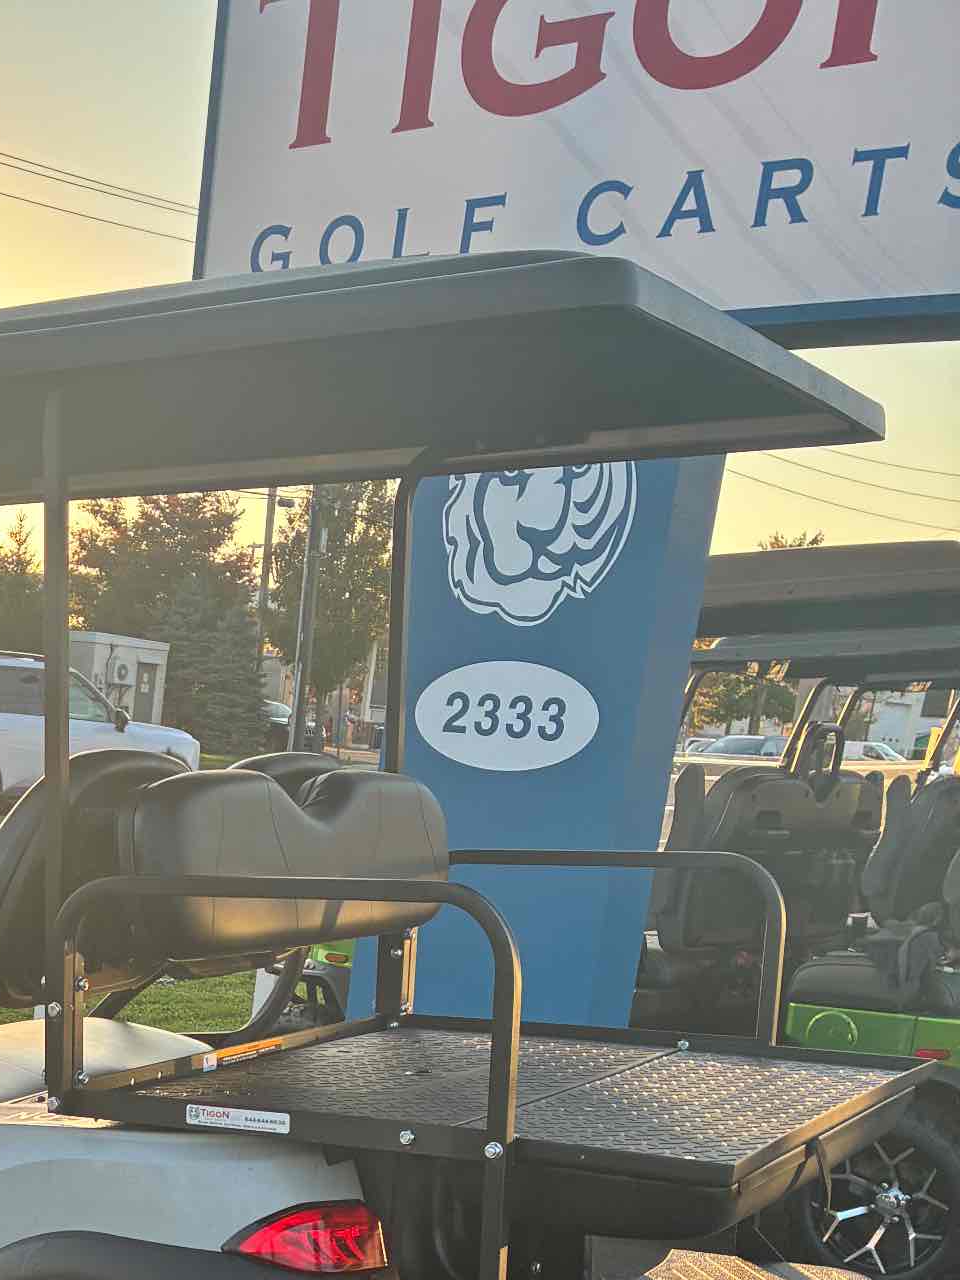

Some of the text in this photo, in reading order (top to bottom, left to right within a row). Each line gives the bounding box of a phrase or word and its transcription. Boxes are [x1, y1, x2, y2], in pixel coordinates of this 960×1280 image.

[259, 0, 879, 149] TIGO
[249, 193, 508, 272] GOLF
[442, 691, 567, 742] 2333
